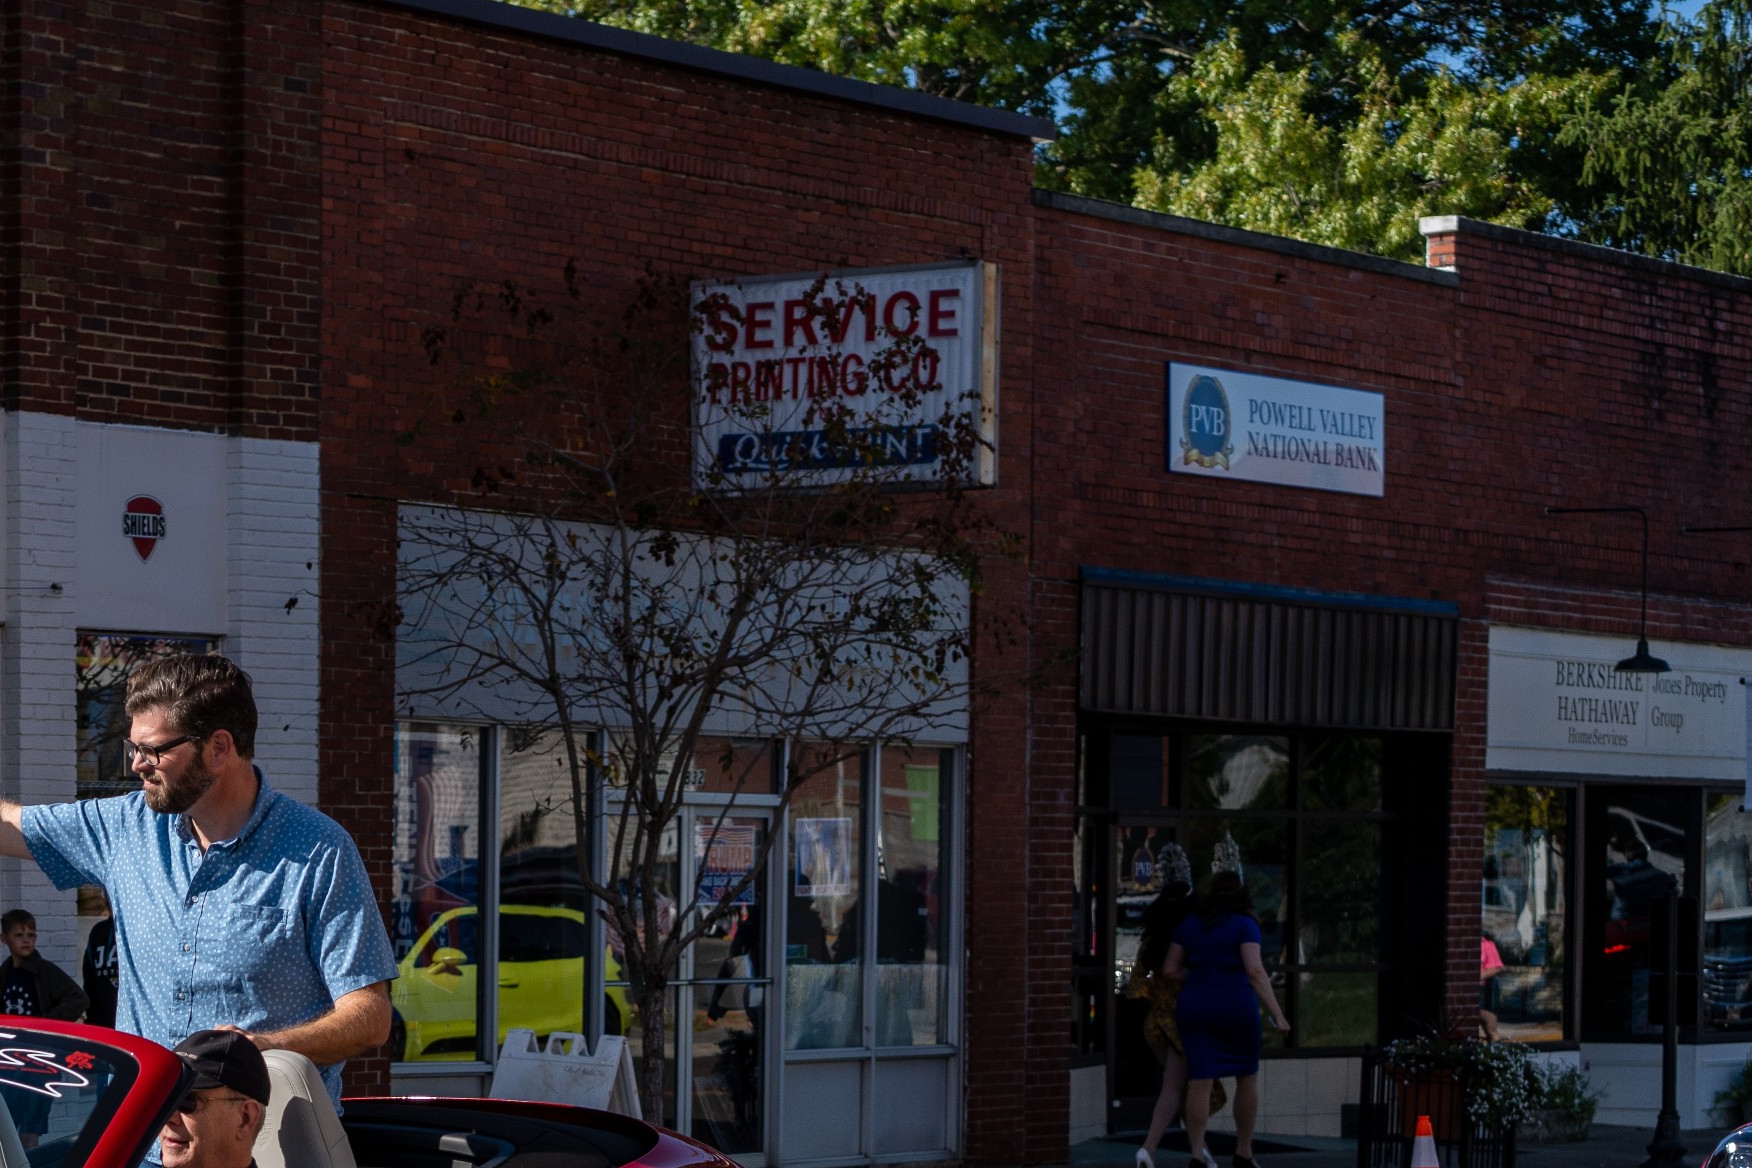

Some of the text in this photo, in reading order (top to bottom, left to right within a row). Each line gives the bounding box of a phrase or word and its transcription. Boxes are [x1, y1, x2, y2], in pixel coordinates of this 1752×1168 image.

[705, 289, 960, 351] SERVICE
[708, 353, 867, 404] PRINTING
[1190, 404, 1225, 436] PVB
[1249, 399, 1377, 441] POWELL VALLEY
[1247, 431, 1378, 472] NATIONAL BANK
[123, 513, 166, 537] SHIELDS
[1556, 661, 1728, 703] BERKSHIRE Jones Property
[1557, 696, 1684, 734] HATHAWAY Group
[1568, 726, 1628, 747] HomeServices
